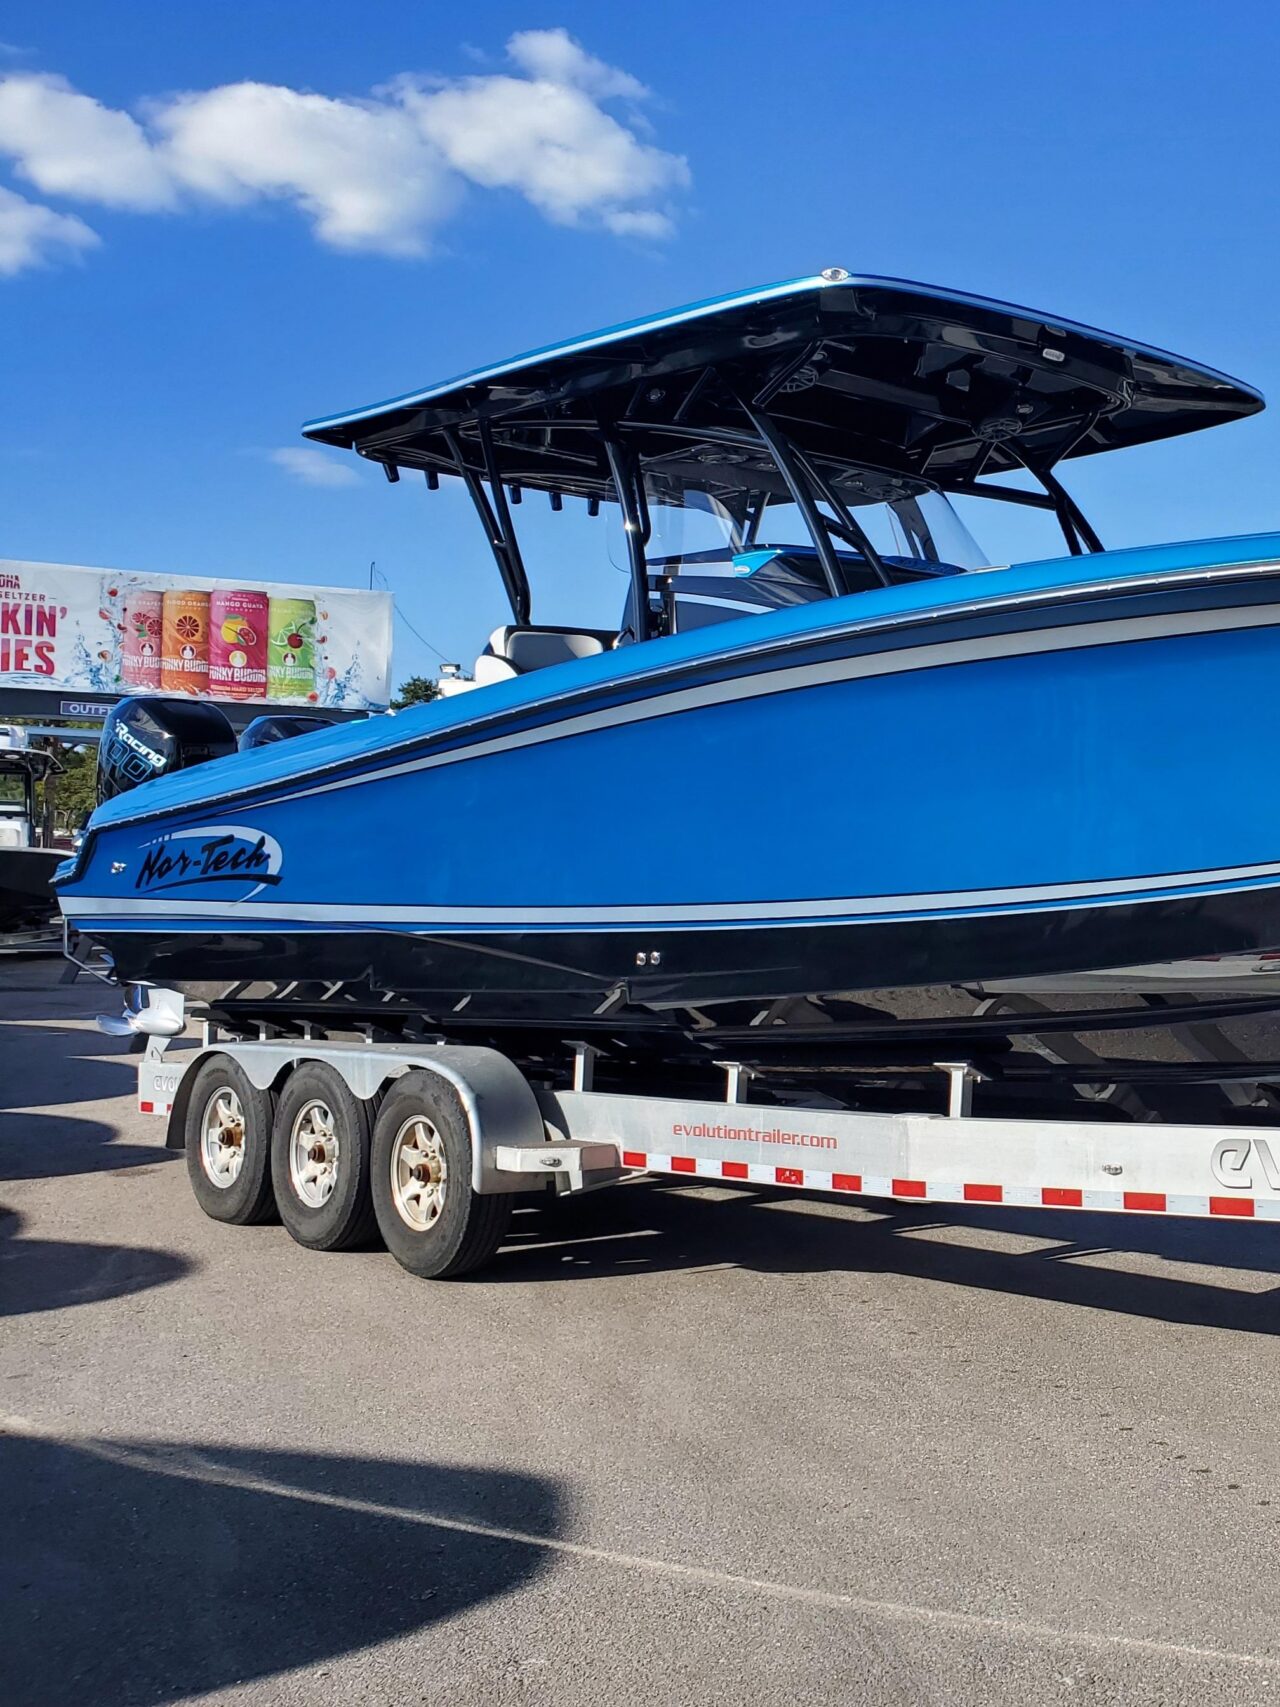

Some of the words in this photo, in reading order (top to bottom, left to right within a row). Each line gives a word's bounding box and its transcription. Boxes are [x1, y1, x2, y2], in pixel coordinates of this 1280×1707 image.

[0, 590, 46, 602] SELTZER
[135, 834, 271, 888] Nor-Tech
[672, 1123, 838, 1150] evolutiontrailer.com
